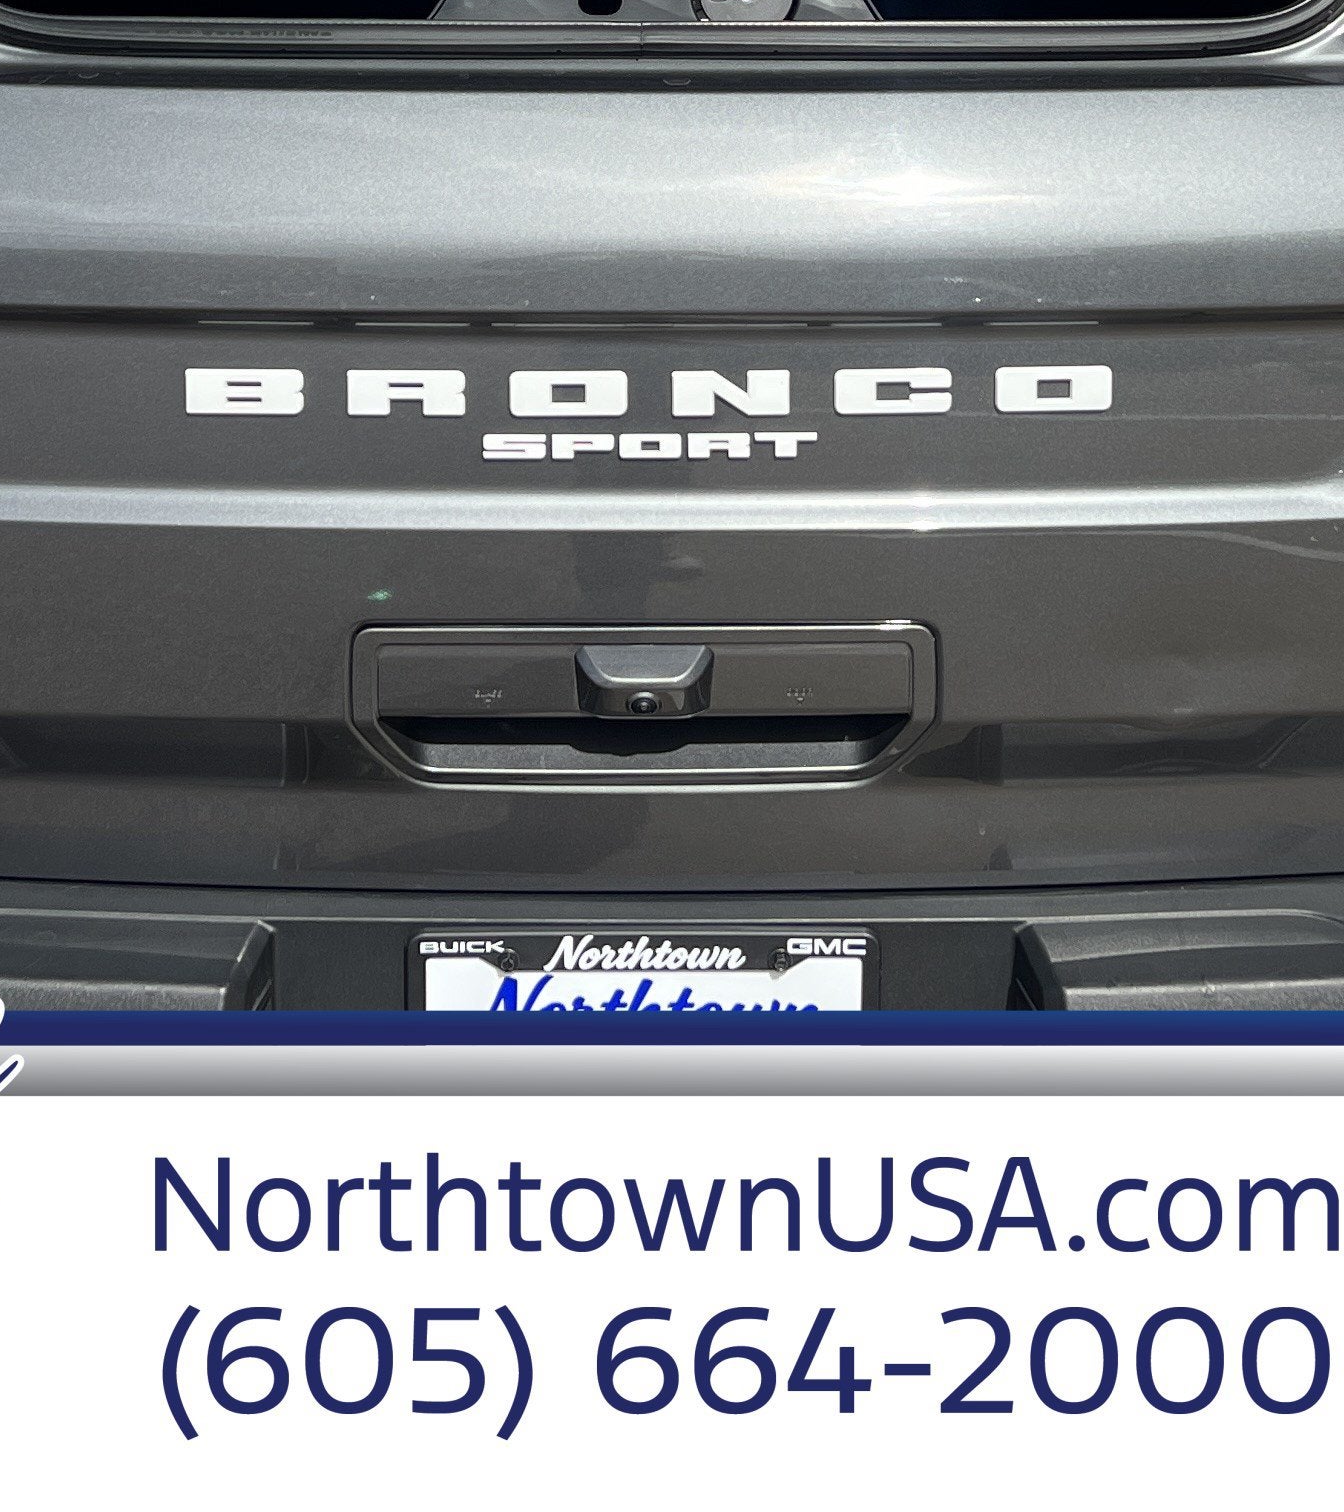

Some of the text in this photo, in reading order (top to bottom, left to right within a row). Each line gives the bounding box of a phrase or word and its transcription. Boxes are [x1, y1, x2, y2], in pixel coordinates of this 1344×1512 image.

[184, 365, 1115, 418] BRONCO
[482, 431, 819, 460] SPORT
[419, 934, 867, 971] BUICK Northtown GMC
